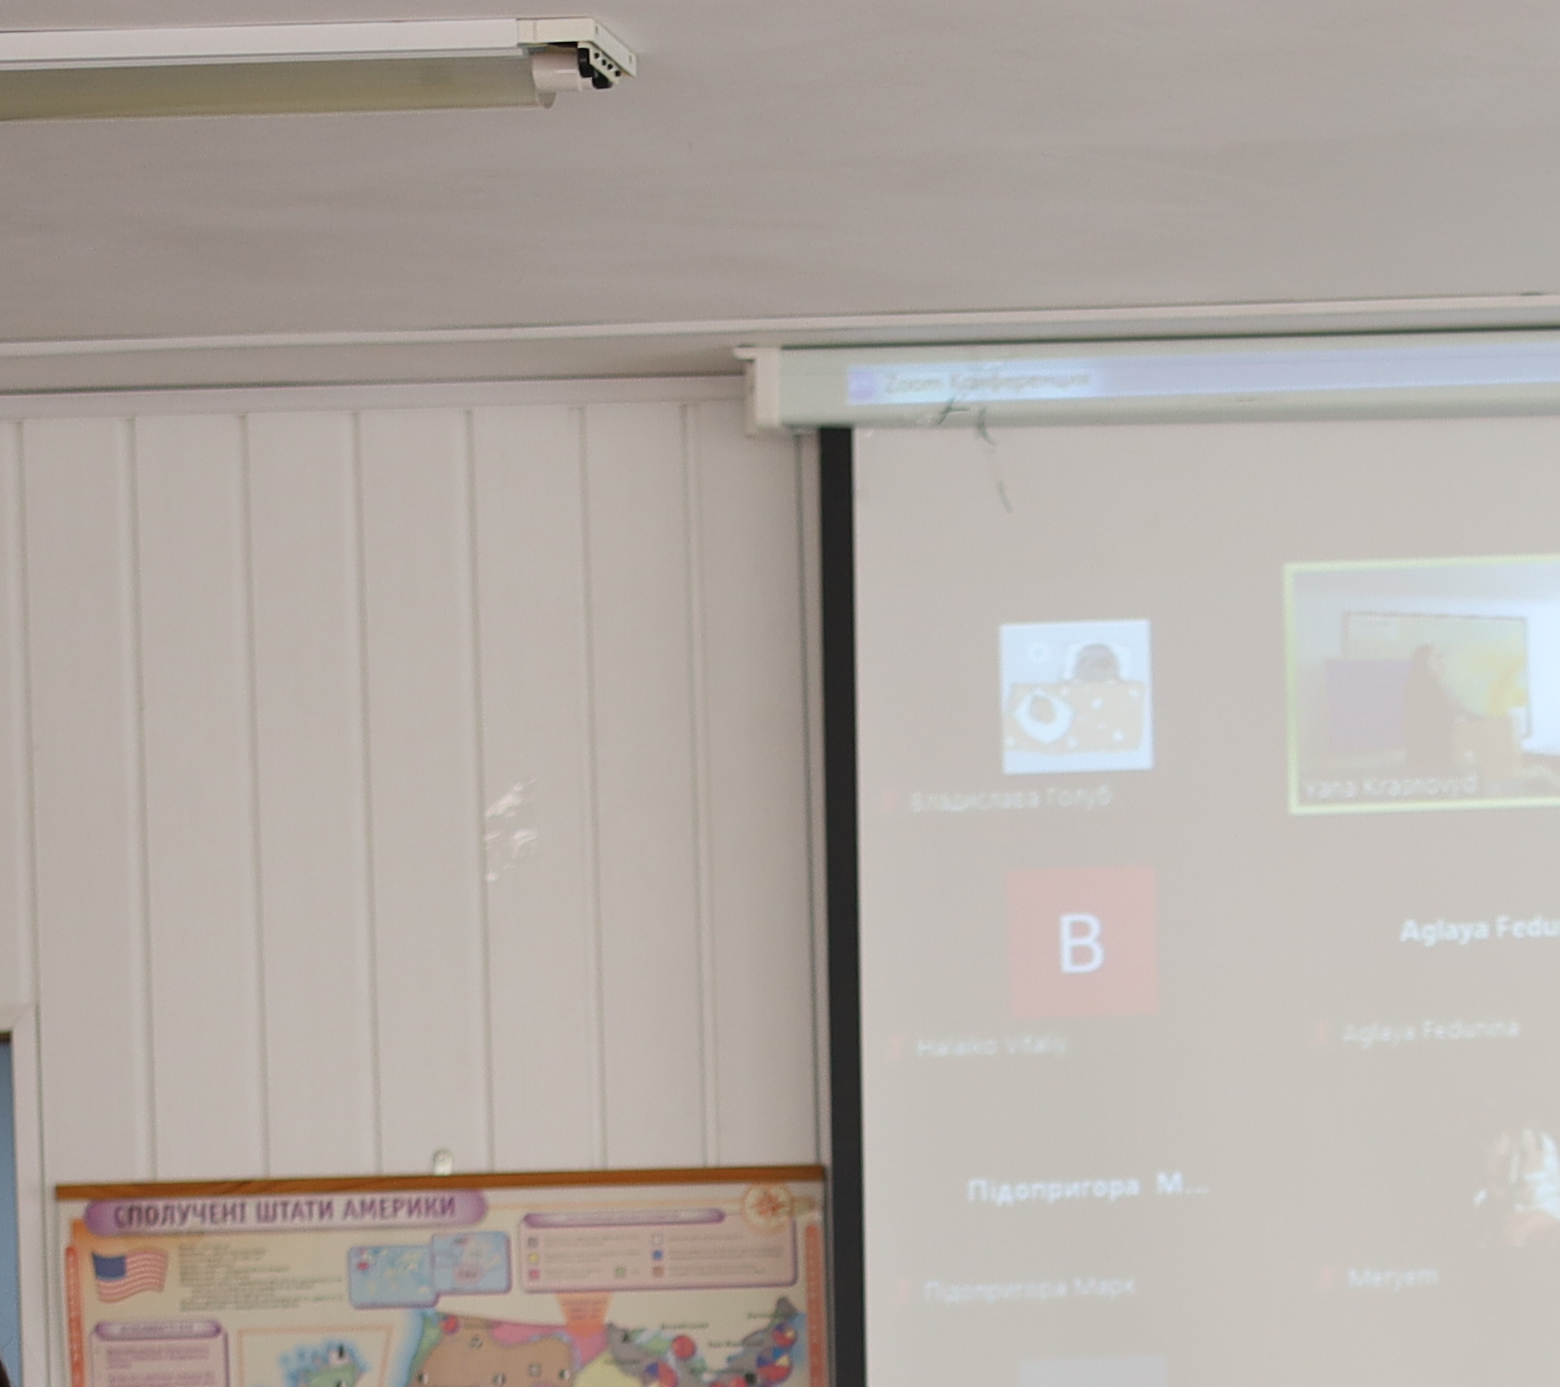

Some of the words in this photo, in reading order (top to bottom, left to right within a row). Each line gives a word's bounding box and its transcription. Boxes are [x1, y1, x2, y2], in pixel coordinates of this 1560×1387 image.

[1399, 917, 1489, 948] Aglaya
[967, 1175, 1140, 1206] Підопригора
[112, 1199, 248, 1230] СПОЛУЧЕНІ
[256, 1198, 335, 1223] ШТАТИ
[343, 1194, 457, 1221] АМЕРИКИ
